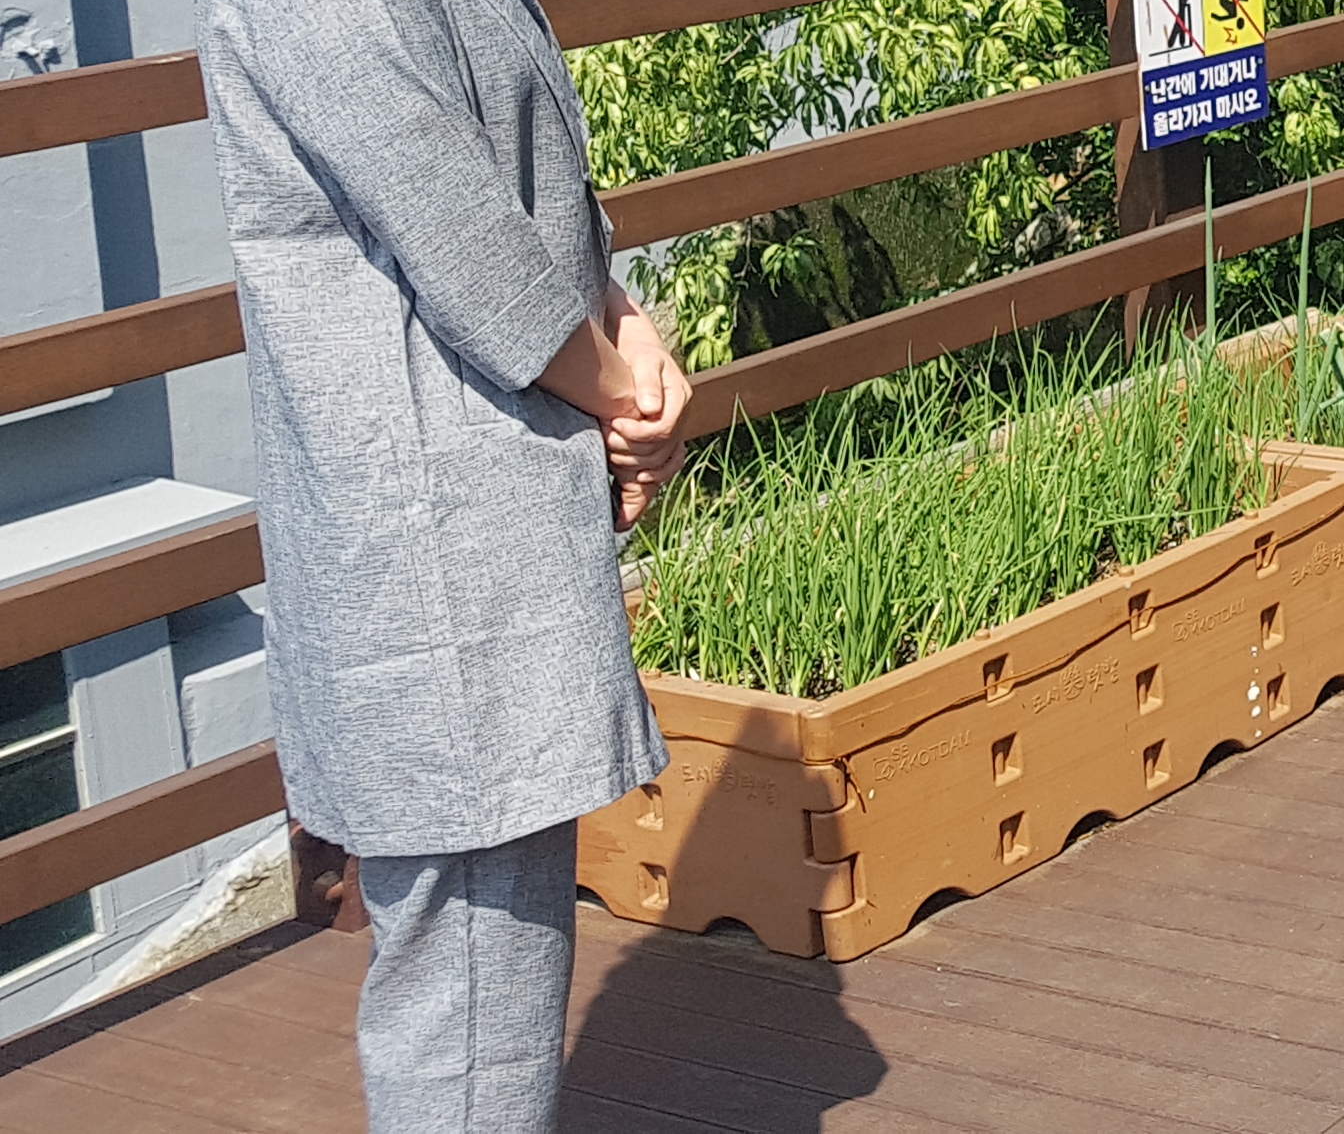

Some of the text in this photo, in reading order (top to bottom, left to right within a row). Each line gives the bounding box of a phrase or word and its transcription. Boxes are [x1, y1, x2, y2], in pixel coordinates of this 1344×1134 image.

[1150, 55, 1258, 105] 난간에 기대거나
[1152, 88, 1262, 138] 올라가지 마시오
